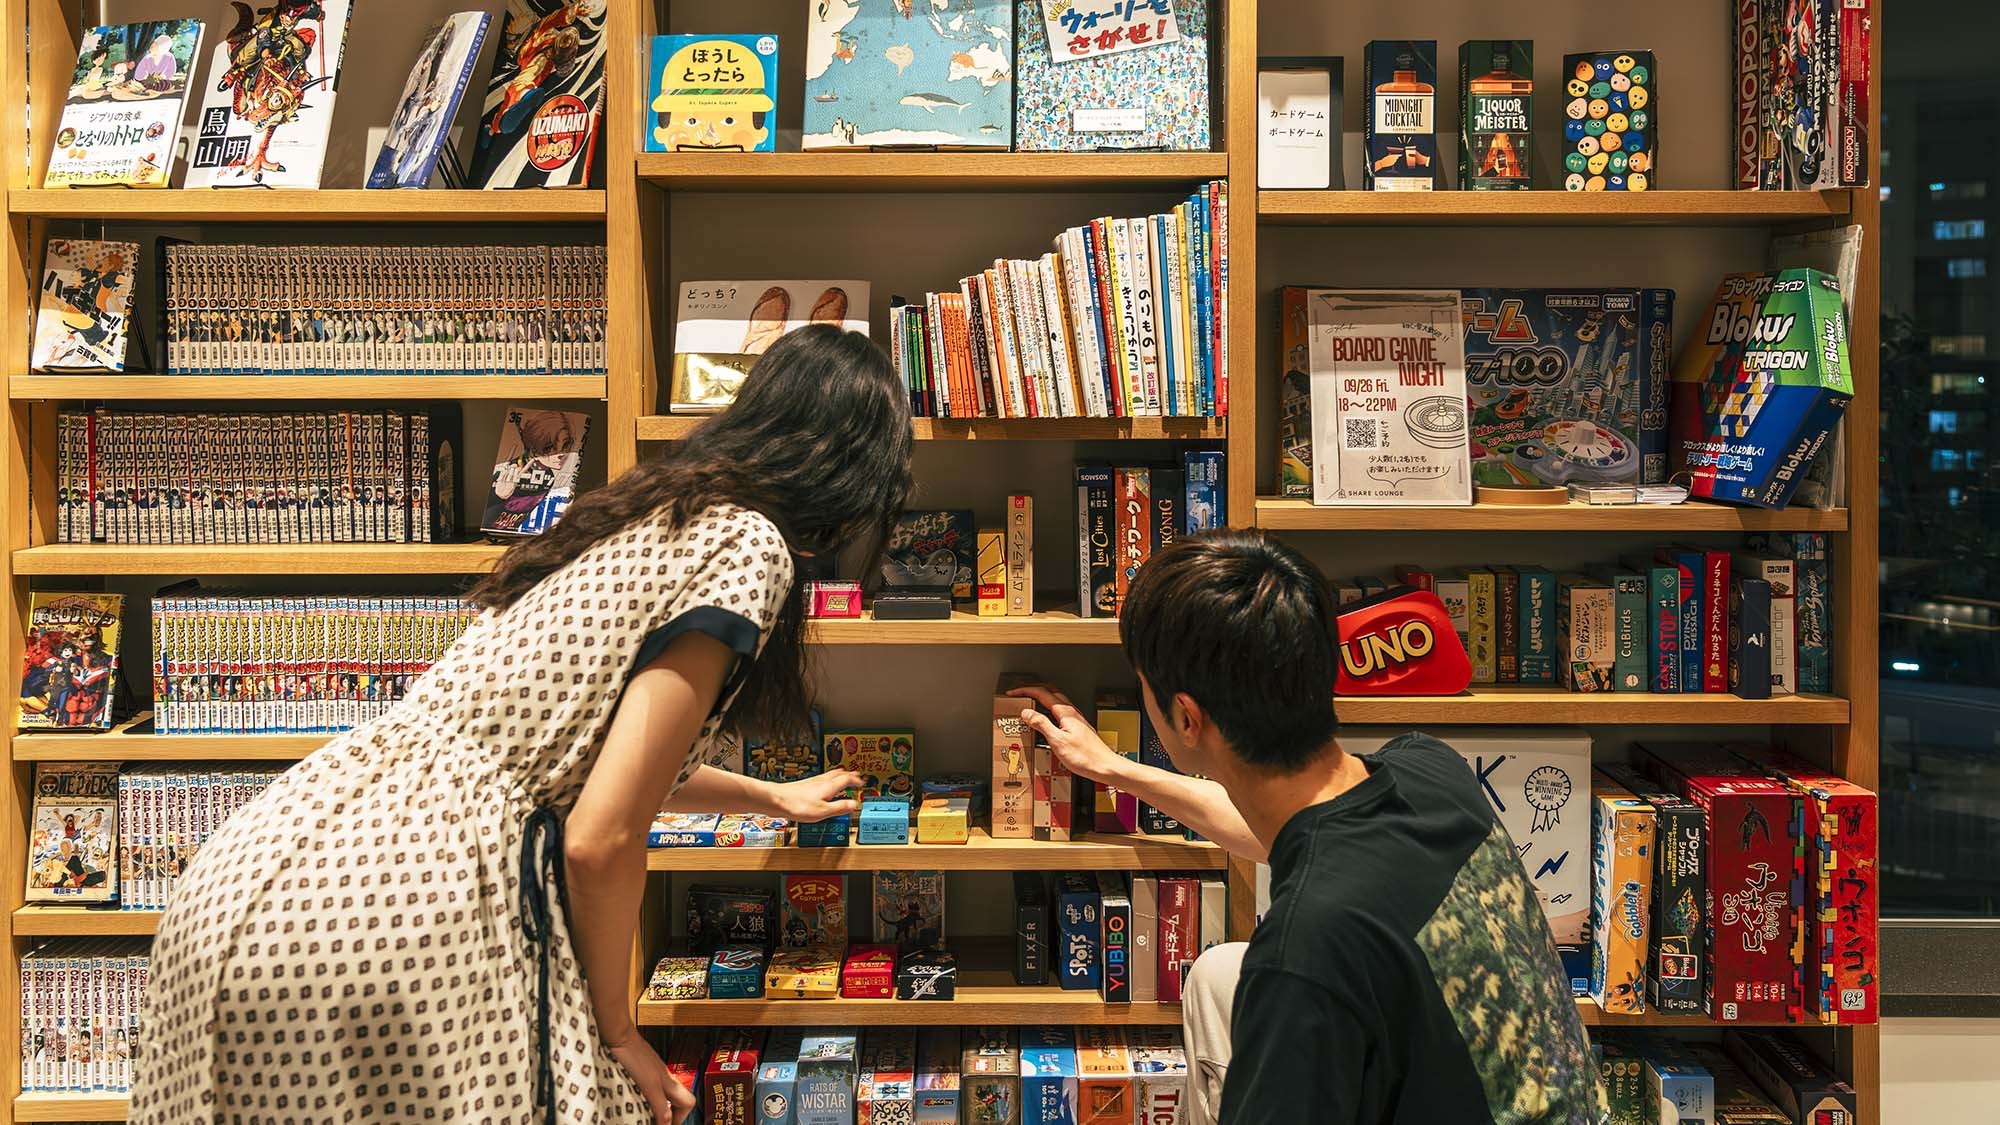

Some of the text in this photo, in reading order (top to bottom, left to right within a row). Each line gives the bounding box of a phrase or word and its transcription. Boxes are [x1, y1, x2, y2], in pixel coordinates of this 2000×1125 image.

[1067, 19, 1167, 56] さがせ!
[692, 48, 740, 64] ぼうし
[682, 67, 745, 83] とったら
[1741, 0, 1757, 183] MONOPOLY
[90, 111, 142, 122] ジブリの食卓
[1270, 110, 1324, 119] カードゲーム
[1384, 98, 1423, 113] MIDNIGHT
[1479, 98, 1523, 115] LIQUOR
[531, 112, 587, 137] UZUMAKI
[1384, 112, 1423, 127] COCKTAIL
[1474, 114, 1528, 131] MEISTER
[75, 125, 144, 147] となりのトトロ
[1269, 128, 1324, 138] ボードゲーム
[1845, 128, 1855, 181] MONOPOLY
[687, 288, 737, 300] どっち?
[1722, 277, 1774, 300] ブロックス
[1121, 286, 1138, 361] きょうりゅう
[1138, 289, 1155, 348] のりもの
[1706, 303, 1795, 346] Blokus
[1333, 337, 1437, 362] BOARD GAME
[1824, 319, 1840, 364] Blokus
[1744, 350, 1809, 370] TRIGON
[1399, 362, 1446, 386] NIGHT
[1344, 379, 1373, 395] 09/26
[1775, 437, 1812, 482] Blokus
[1127, 500, 1142, 577] ッチワーク
[1013, 530, 1024, 592] バトルライン
[1621, 608, 1632, 658] CuBirds
[1683, 612, 1691, 650] DYING
[1690, 599, 1698, 650] MESSAGE
[1339, 619, 1434, 677] UNO
[1659, 609, 1677, 690] CAN'T STOP
[1534, 785, 1563, 796] WINNING
[1540, 794, 1555, 802] GAME
[120, 789, 128, 835] ONE PIECE
[143, 789, 151, 835] ONE PIECE
[155, 789, 163, 834] ONE PIECE
[716, 831, 741, 846] UNO
[1686, 827, 1700, 876] ブロックス
[790, 883, 840, 900] コヨーテ
[1740, 862, 1778, 955] ウボンゴ
[1838, 868, 1869, 972] ウボンゴ
[731, 915, 766, 932] 人狼
[1026, 921, 1036, 970] FIXER
[1108, 915, 1125, 992] YUBIBO
[1167, 914, 1180, 971] コードネーム
[1769, 983, 1779, 1000] 10+
[809, 1083, 838, 1092] RATS OF
[801, 1093, 846, 1110] WISTAR
